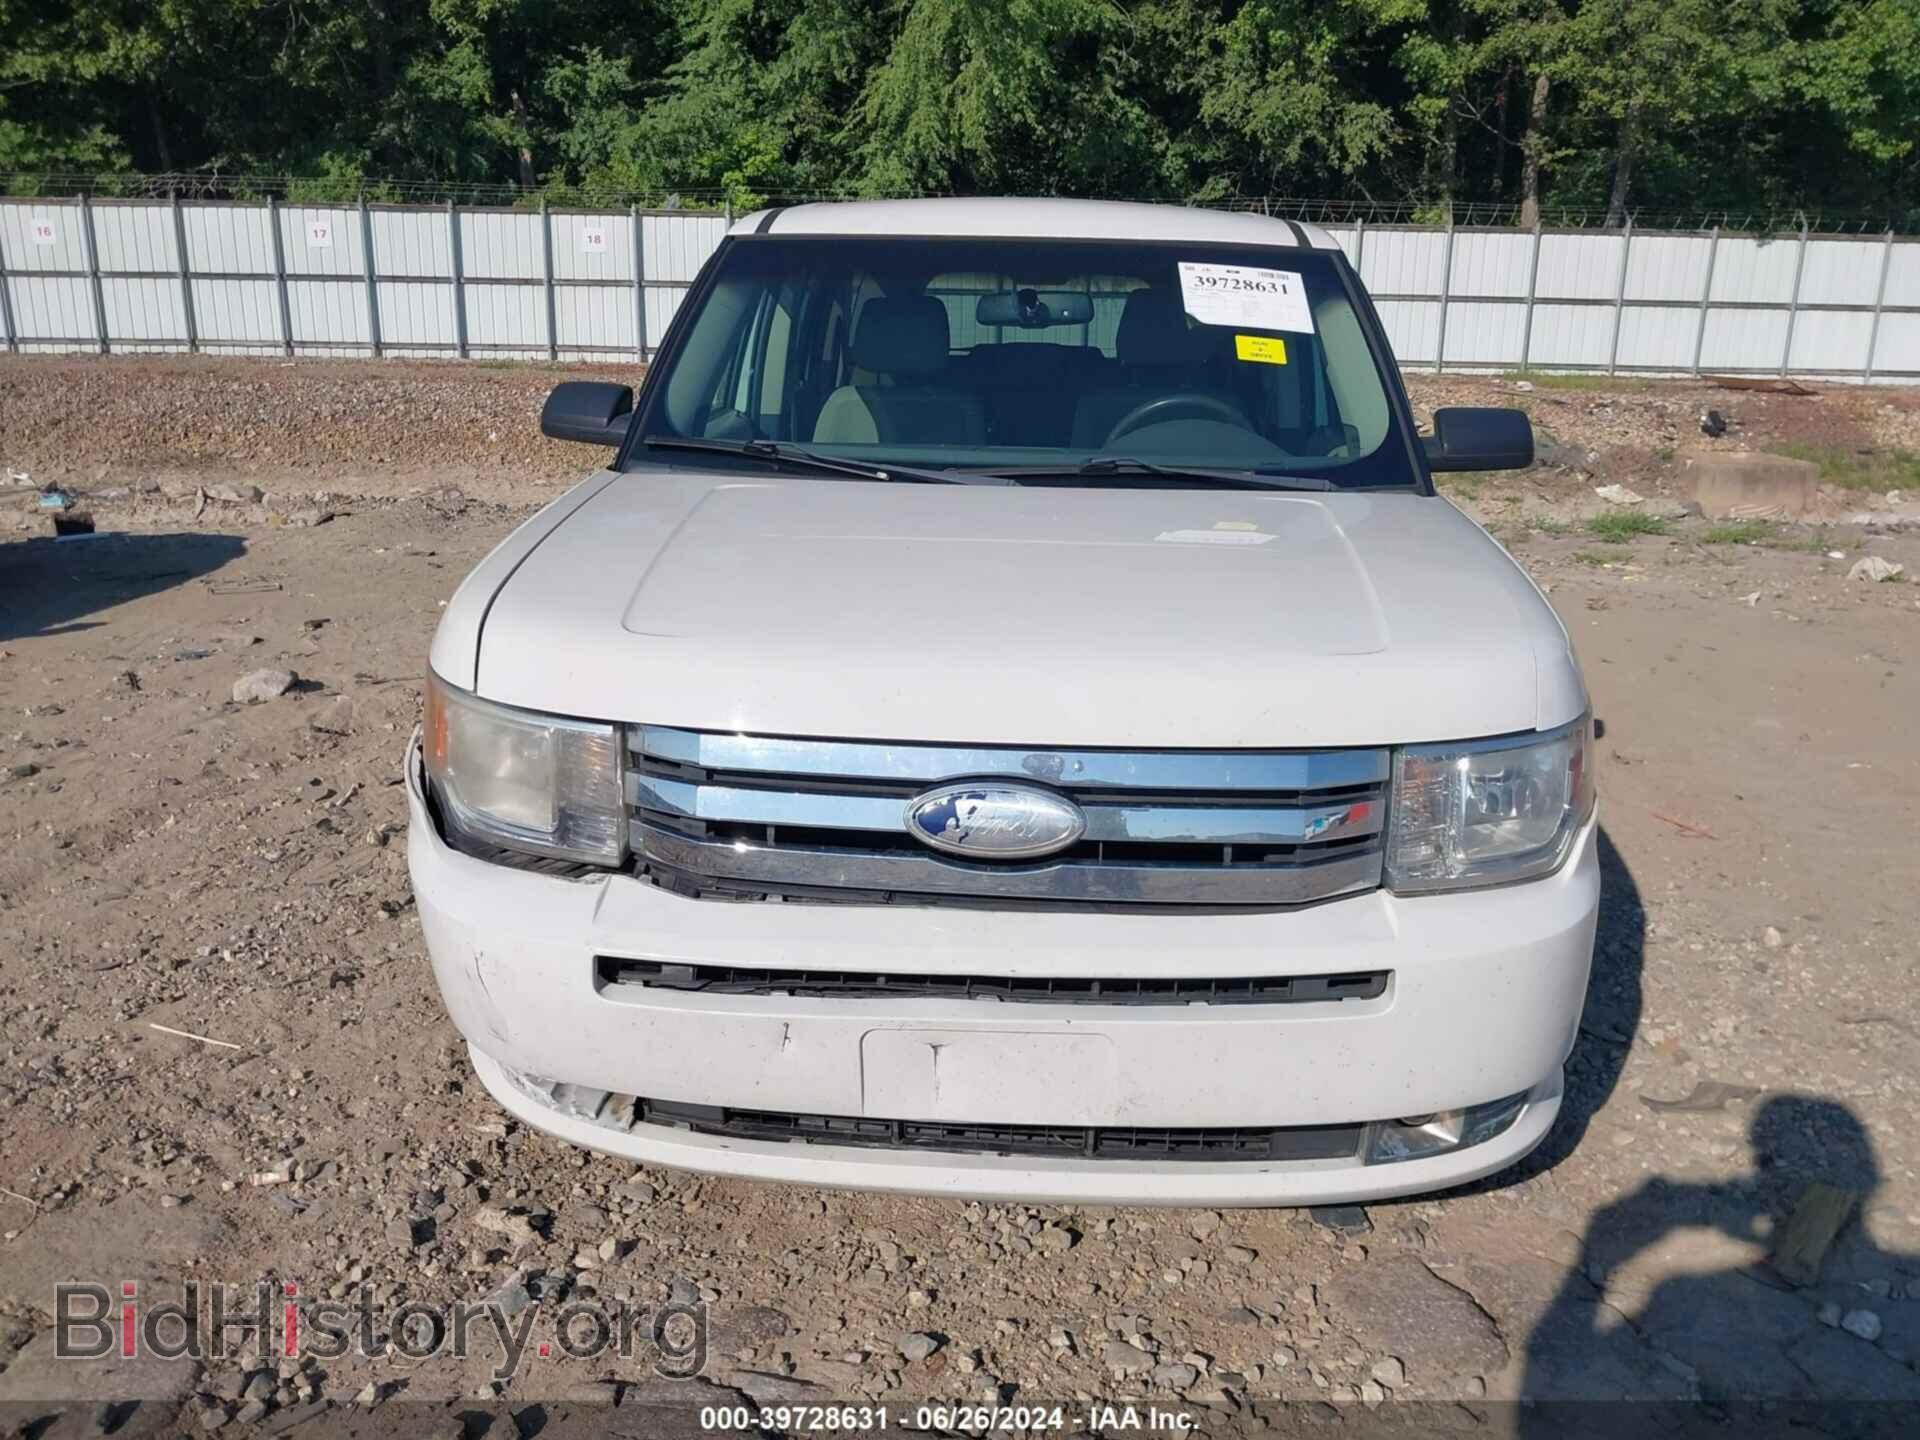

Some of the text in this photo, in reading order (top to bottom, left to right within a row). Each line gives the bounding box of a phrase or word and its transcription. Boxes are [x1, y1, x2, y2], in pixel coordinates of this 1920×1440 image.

[37, 226, 51, 236] 16
[313, 229, 326, 238] 17
[587, 235, 601, 244] 18
[1193, 275, 1289, 295] 39728631
